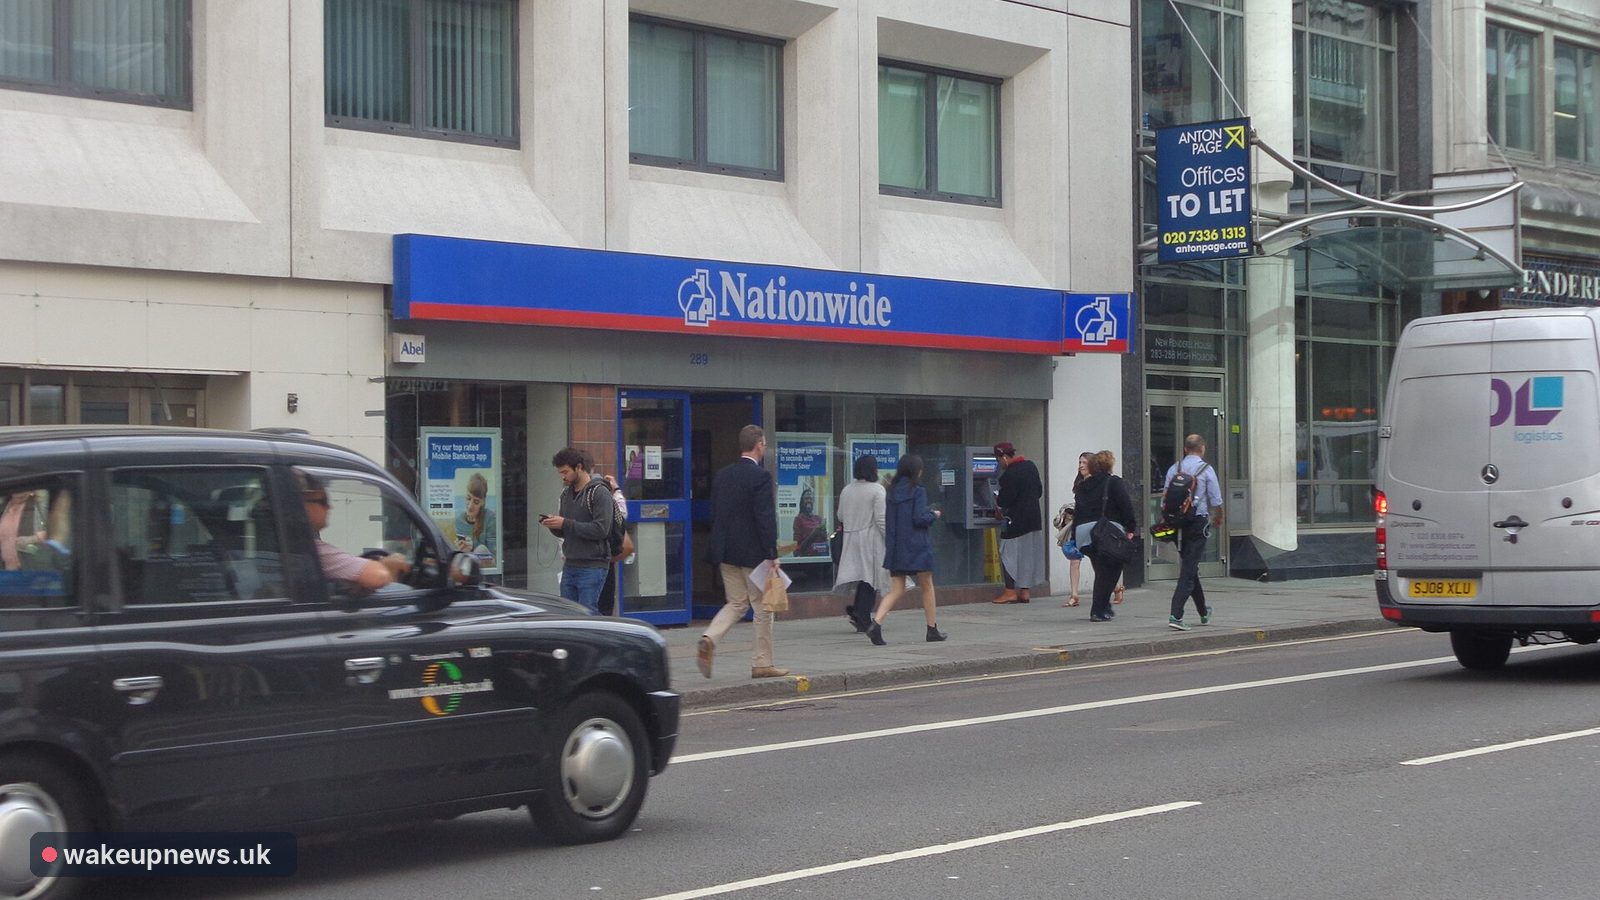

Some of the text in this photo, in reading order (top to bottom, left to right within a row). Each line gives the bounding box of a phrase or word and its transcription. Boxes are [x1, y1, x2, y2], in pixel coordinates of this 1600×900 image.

[1178, 128, 1222, 144] ANTON
[1192, 141, 1222, 155] PAGE
[1181, 166, 1245, 187] Offices
[1167, 188, 1246, 218] TO LET
[1163, 226, 1246, 244] 020 7336 1313
[1175, 241, 1247, 254] antonpage.com
[1508, 269, 1600, 300] ENDER
[719, 270, 892, 327] Nationwide
[401, 341, 424, 356] Abel
[690, 352, 708, 365] 289
[1514, 431, 1563, 444] logistics
[432, 443, 441, 452] Try
[453, 443, 462, 452] top
[463, 443, 479, 451] rated
[432, 452, 452, 460] Mobile
[452, 452, 475, 461] Banking
[1414, 582, 1472, 595] SJ08 XLU
